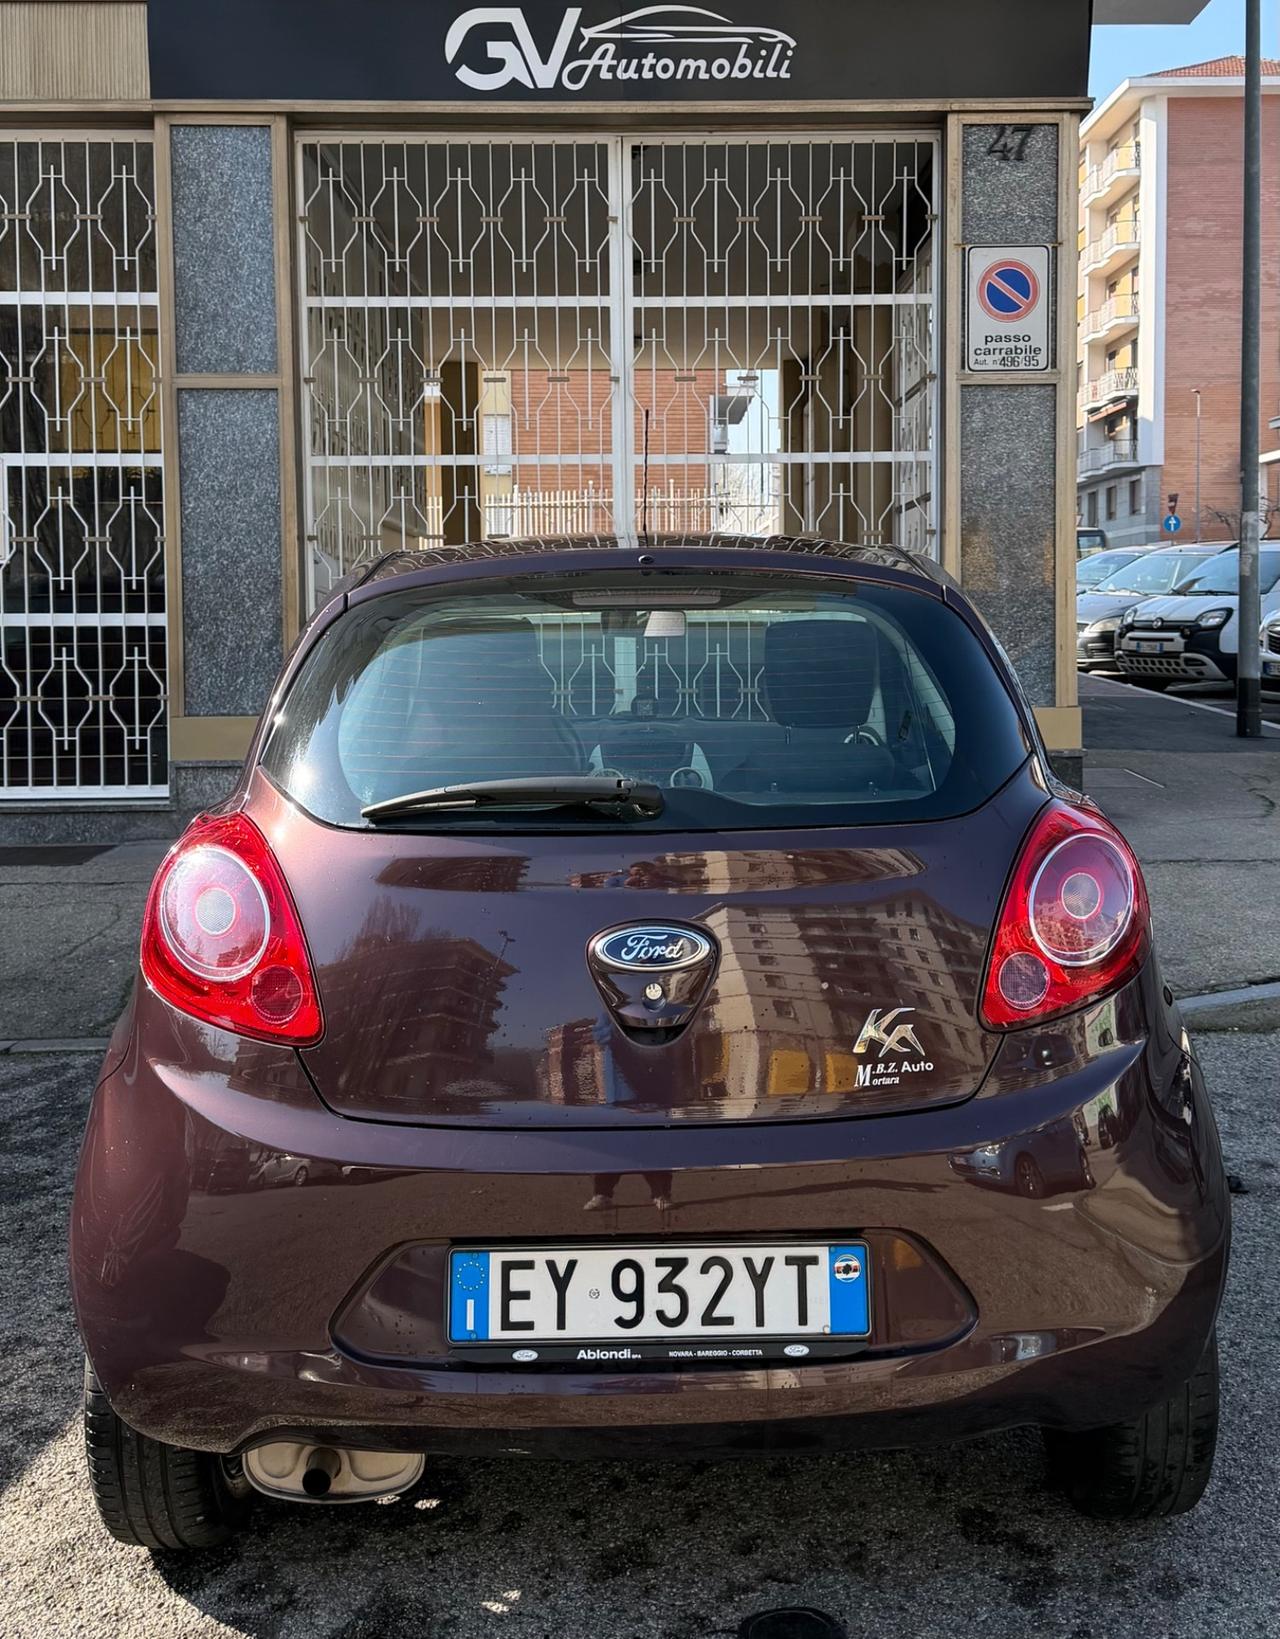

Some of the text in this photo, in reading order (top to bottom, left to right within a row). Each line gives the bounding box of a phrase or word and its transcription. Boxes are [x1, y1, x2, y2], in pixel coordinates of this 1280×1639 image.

[445, 7, 793, 91] GV Automobili
[987, 126, 1034, 161] 47
[984, 334, 1031, 346] passo
[974, 345, 1042, 356] carrabile
[621, 934, 685, 961] Ford
[901, 1060, 934, 1073] Auto
[500, 1255, 819, 1331] EY 932YT
[466, 1299, 475, 1331] I
[577, 1349, 631, 1360] Ablondi
[669, 1350, 694, 1358] NOVARA
